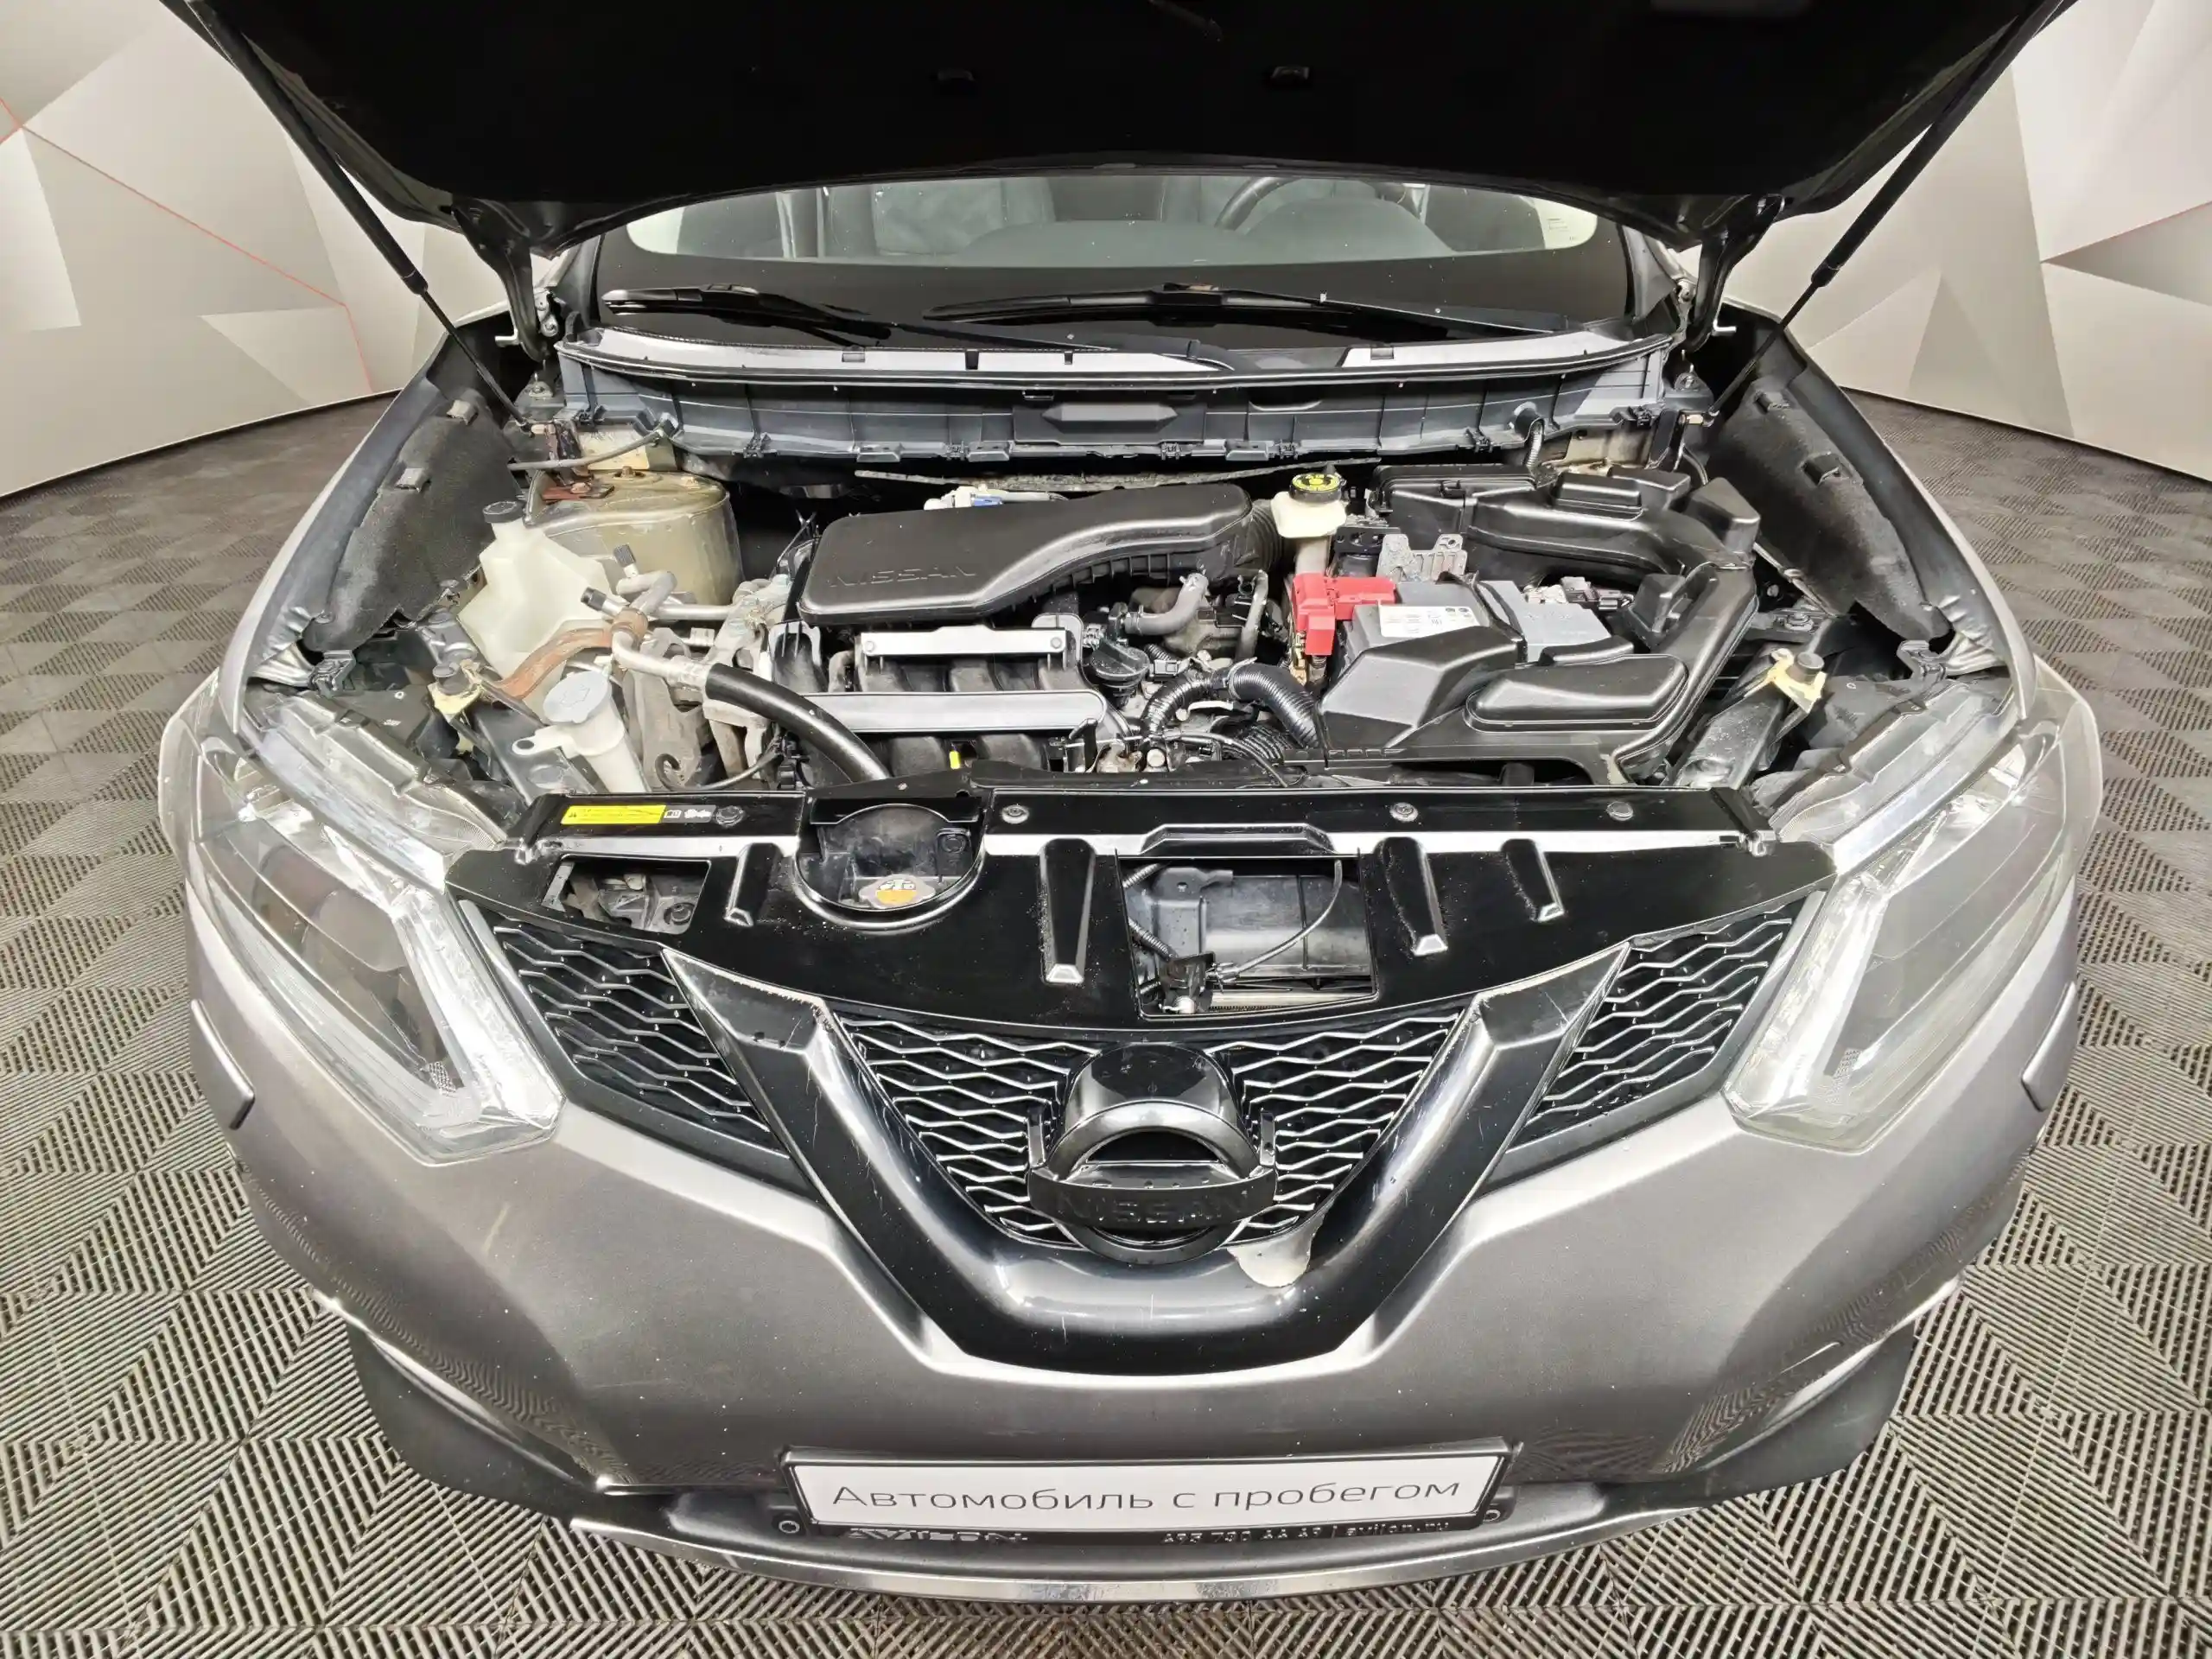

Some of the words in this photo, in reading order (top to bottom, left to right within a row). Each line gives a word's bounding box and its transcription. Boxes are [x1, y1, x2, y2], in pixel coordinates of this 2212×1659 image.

[826, 565, 977, 588] NISSAN
[1059, 1192, 1241, 1224] NISSAN
[833, 1486, 1154, 1510] Автомобиль
[1173, 1492, 1196, 1509] с
[1214, 1482, 1460, 1511] пробегом
